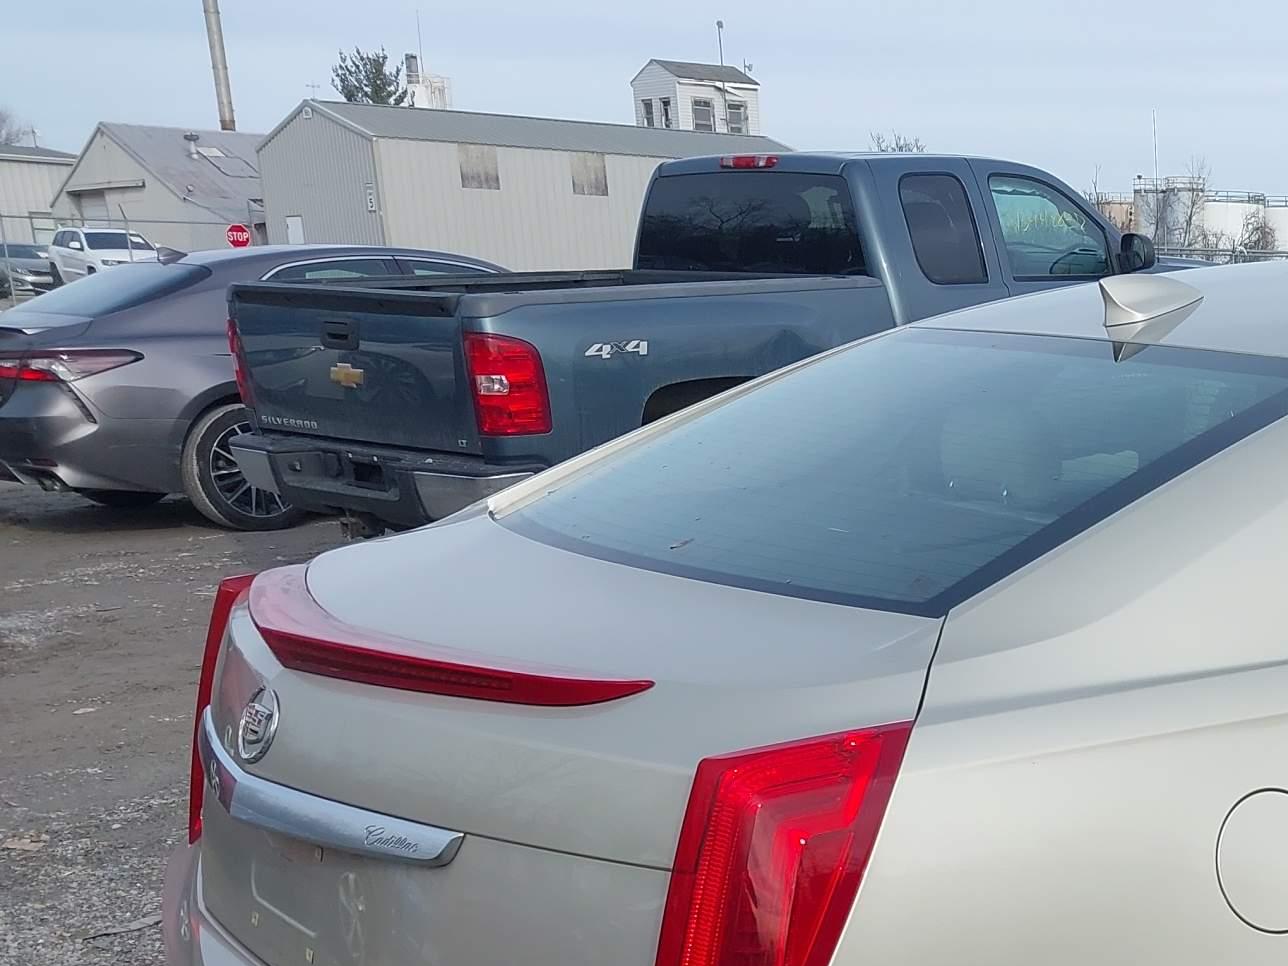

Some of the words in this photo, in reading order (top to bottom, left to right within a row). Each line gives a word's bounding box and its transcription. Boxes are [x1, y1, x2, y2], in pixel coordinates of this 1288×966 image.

[227, 231, 249, 242] STOP
[261, 415, 318, 429] SILVERADO
[365, 824, 419, 853] Cadillac
